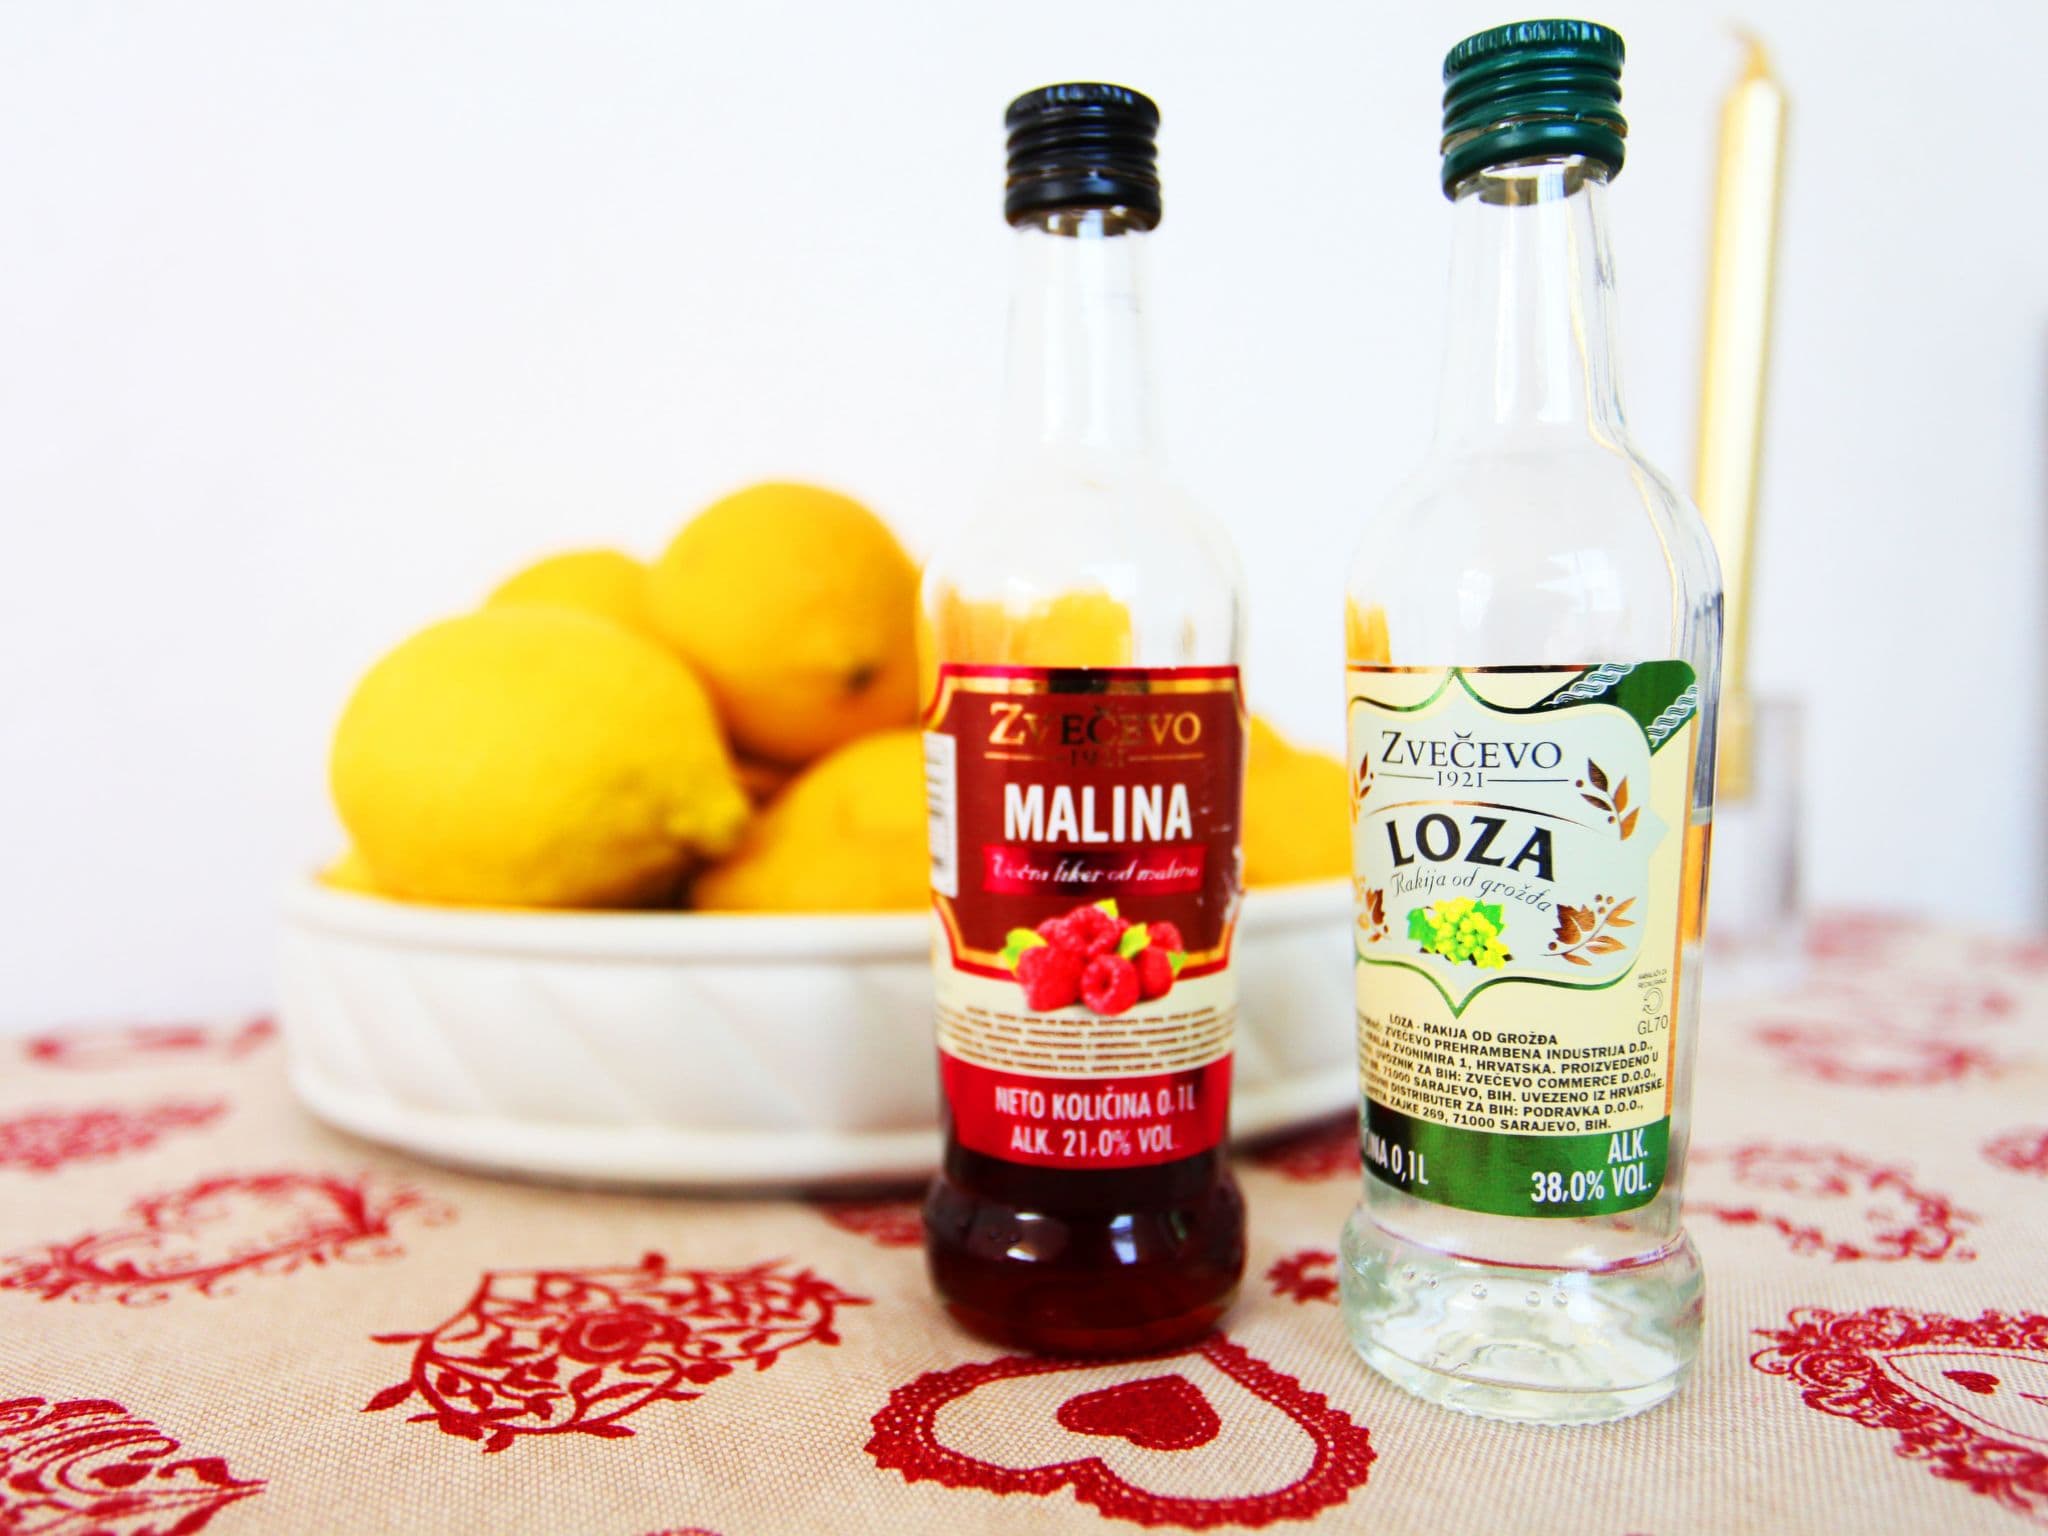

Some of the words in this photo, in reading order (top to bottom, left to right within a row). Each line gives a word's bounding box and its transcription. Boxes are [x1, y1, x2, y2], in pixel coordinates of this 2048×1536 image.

[1381, 730, 1563, 769] ZVEČEVO
[1436, 771, 1483, 788] 1921
[1004, 783, 1193, 843] MALINA
[1386, 813, 1556, 883] LOZA
[1107, 859, 1138, 881] od
[1391, 867, 1447, 898] Rakija
[1452, 867, 1479, 888] od
[1481, 879, 1552, 913] grožđa
[1389, 1013, 1414, 1030] LOZA
[1423, 1022, 1468, 1040] RAKIJA
[1472, 1030, 1492, 1042] OD
[1497, 1031, 1558, 1045] GROŽĐA
[1637, 1014, 1669, 1036] GL70
[1393, 1041, 1455, 1067] ZVONIMIRA
[1459, 1057, 1472, 1070] 1,
[1476, 1060, 1556, 1074] HRVATSKA.
[1561, 1053, 1650, 1075] PROIZVEDENO
[1652, 1051, 1659, 1063] U
[1434, 1039, 1542, 1060] PREHRAMBENA
[1546, 1044, 1626, 1060] INDUSTRIJA
[1413, 1076, 1482, 1100] SARAJEVO,
[1487, 1089, 1517, 1102] BIH.
[1521, 1091, 1589, 1103] UVEZENO
[1593, 1090, 1606, 1101] IZ
[1609, 1078, 1665, 1100] HRVATSKE.
[1417, 1063, 1432, 1076] ZA
[1435, 1067, 1461, 1082] BIH:
[1466, 1073, 1532, 1088] ZVEČEVO
[1537, 1074, 1618, 1089] COMMERCE
[995, 1086, 1045, 1119] NETO
[1052, 1085, 1151, 1122] KOLIČINA
[1390, 1082, 1461, 1110] DISTRIBUTER
[1466, 1101, 1485, 1113] ZA
[1489, 1104, 1519, 1116] BIH:
[1523, 1105, 1600, 1118] PODRAVKA
[1390, 1095, 1420, 1114] ZAJKE
[1422, 1107, 1448, 1123] 269,
[1453, 1113, 1495, 1129] 71000
[1500, 1119, 1580, 1133] SARAJEVO,
[1584, 1118, 1611, 1131] BIH.
[1010, 1125, 1054, 1156] ALK.
[1062, 1128, 1131, 1158] 21,0%
[1607, 1129, 1648, 1165] ALK.
[1391, 1144, 1429, 1185] 0,1L
[1530, 1169, 1605, 1203] 38,0%
[1613, 1163, 1652, 1197] VOL.
